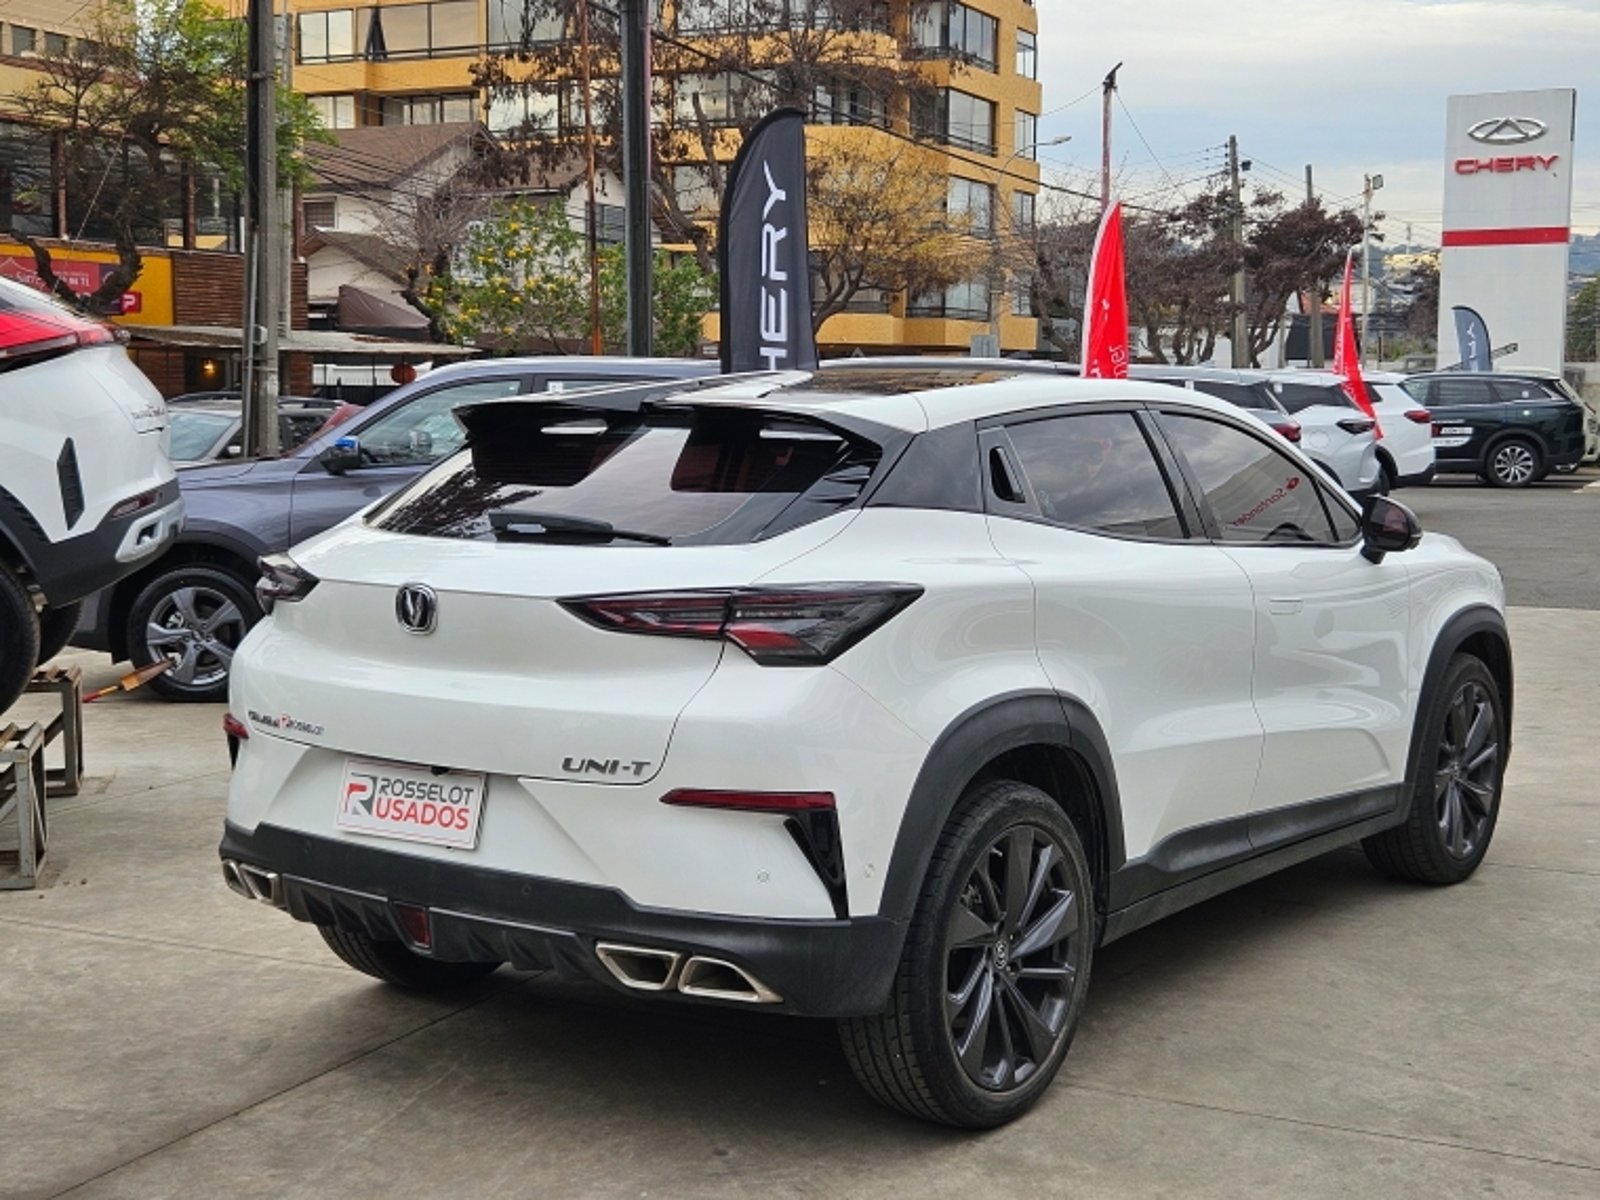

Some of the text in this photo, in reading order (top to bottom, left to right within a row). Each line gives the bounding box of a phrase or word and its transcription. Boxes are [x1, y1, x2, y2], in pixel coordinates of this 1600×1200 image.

[1455, 155, 1559, 175] CHERY
[561, 757, 651, 776] UNI-T
[378, 778, 475, 805] ROSSELOT
[375, 797, 471, 831] USADOS
